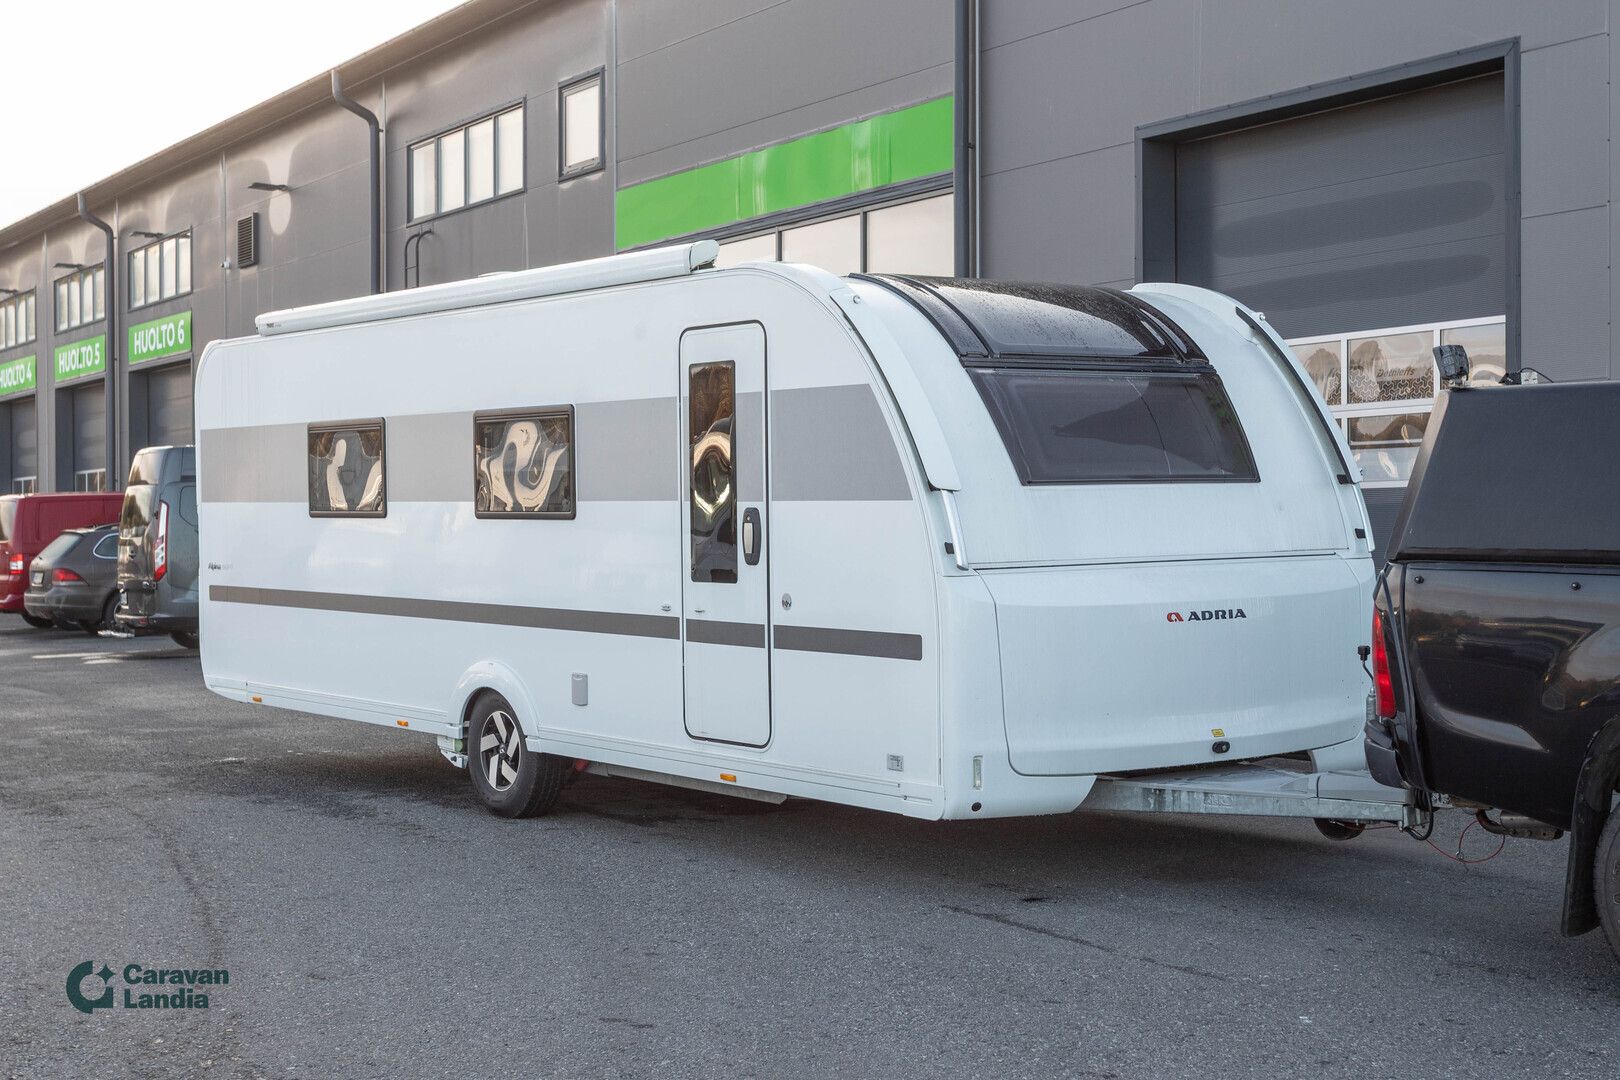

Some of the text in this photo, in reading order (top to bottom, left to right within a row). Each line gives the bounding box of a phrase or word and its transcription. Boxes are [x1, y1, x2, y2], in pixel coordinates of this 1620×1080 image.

[134, 319, 185, 355] HUOLTO 6
[59, 343, 100, 373] HUOLTO 5
[25, 362, 32, 382] 4
[1188, 608, 1247, 622] ADRIA
